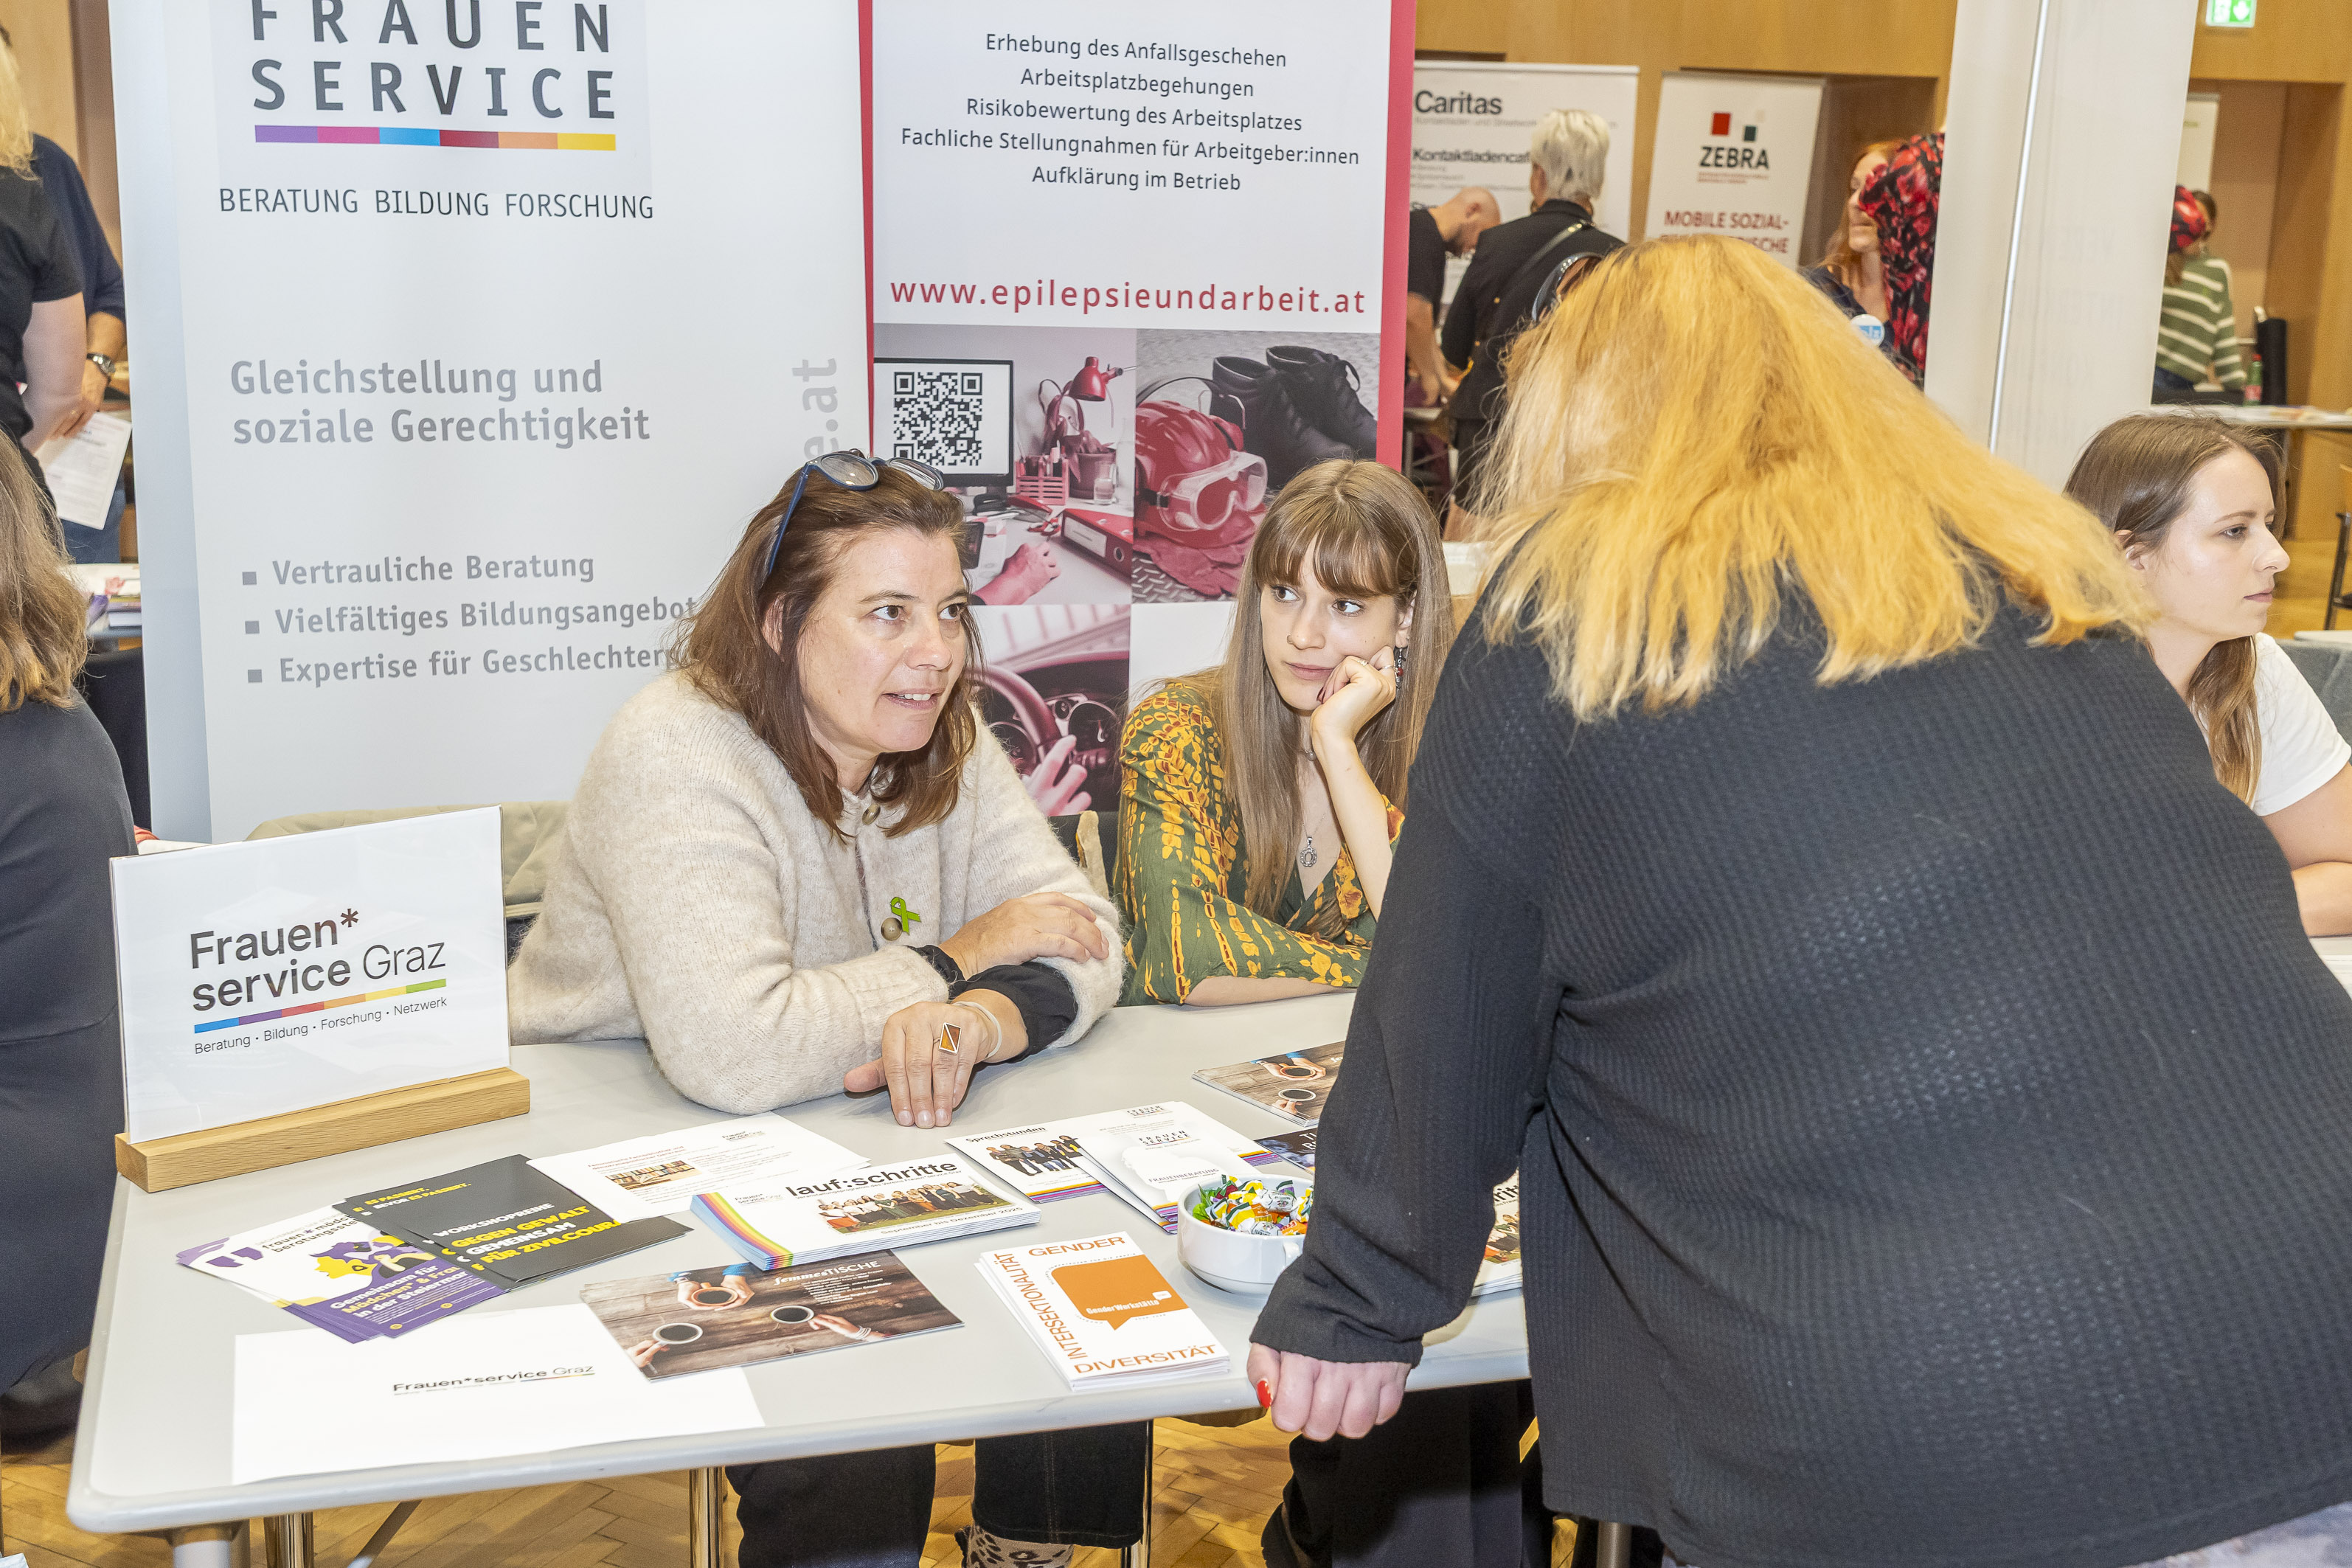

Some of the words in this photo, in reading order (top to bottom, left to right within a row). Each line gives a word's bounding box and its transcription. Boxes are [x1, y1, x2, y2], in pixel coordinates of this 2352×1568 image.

[251, 0, 609, 52] FRAUEN
[985, 33, 1081, 60] Erhebung
[1087, 39, 1120, 57] des
[1125, 41, 1287, 67] Anfallsgeschehen
[251, 59, 615, 119] SERVICE
[1021, 68, 1255, 100] Arbeitsplatzbegehungen
[966, 98, 1130, 127] Risikobewertung
[1136, 106, 1167, 125] des
[1171, 109, 1302, 133] Arbeitsplatzes
[1415, 90, 1502, 115] Caritas
[901, 128, 993, 149] Fachliche
[999, 132, 1156, 159] Stellungnahmen
[1162, 139, 1189, 157] für
[1194, 142, 1359, 165] Arbeitgeber:innen
[1412, 148, 1530, 164] Kontaktladencaf
[1699, 146, 1770, 170] ZEBRA
[1032, 166, 1139, 191] Aufklärung
[1145, 170, 1167, 187] im
[1173, 172, 1241, 191] Betrieb
[220, 188, 358, 213] BERATUNG
[375, 190, 489, 216] BILDUNG
[505, 193, 653, 219] FORSCHUNG
[1664, 210, 1726, 229] MOBILE
[1730, 212, 1789, 230] SOZIAL-
[890, 278, 1365, 314] www.epilepsieundarbeit.at
[231, 359, 517, 402] Gleichstellung
[534, 359, 603, 393] und
[234, 409, 374, 444] soziale
[392, 406, 651, 448] Gerechtigkeit
[272, 556, 453, 586] Vertrauliche
[466, 555, 594, 583] Beratung
[274, 605, 448, 636] Vielfältiges
[461, 597, 696, 631] Bildungsangebot
[280, 653, 418, 687] Expertise
[429, 651, 472, 676] für
[483, 644, 671, 674] Geschlechter
[192, 958, 351, 1011] service
[363, 942, 446, 980] Graz
[195, 1035, 251, 1055] Beratung
[263, 1024, 308, 1041] Bildung
[321, 1008, 382, 1030] Forschung
[394, 996, 448, 1016] Netzwerk
[965, 1127, 1047, 1143] Sprechstunden
[1139, 1130, 1186, 1142] FRAUEN
[1142, 1133, 1190, 1145] SERVICE
[785, 1161, 958, 1197] lauf:schritte
[315, 1215, 351, 1231] mädc
[432, 1203, 555, 1237] WORKSHOPREIHE
[451, 1227, 518, 1248] GEGEN
[516, 1206, 591, 1231] GEWALT
[465, 1221, 577, 1255] GEMEINSAM
[1028, 1236, 1125, 1257] GENDER
[479, 1247, 521, 1264] FÜR
[330, 1272, 418, 1309] Gemeinsam
[414, 1265, 439, 1276] für
[774, 1260, 881, 1286] femmesTISCHE
[353, 1308, 373, 1318] in
[372, 1297, 399, 1311] der
[397, 1270, 468, 1300] Steiermar
[994, 1253, 1089, 1360] INTERSEKTIONALITÄT
[1085, 1299, 1160, 1315] GenderWerkstätte
[553, 1365, 594, 1376] Graz
[1074, 1344, 1216, 1374] DIVERSITÄT
